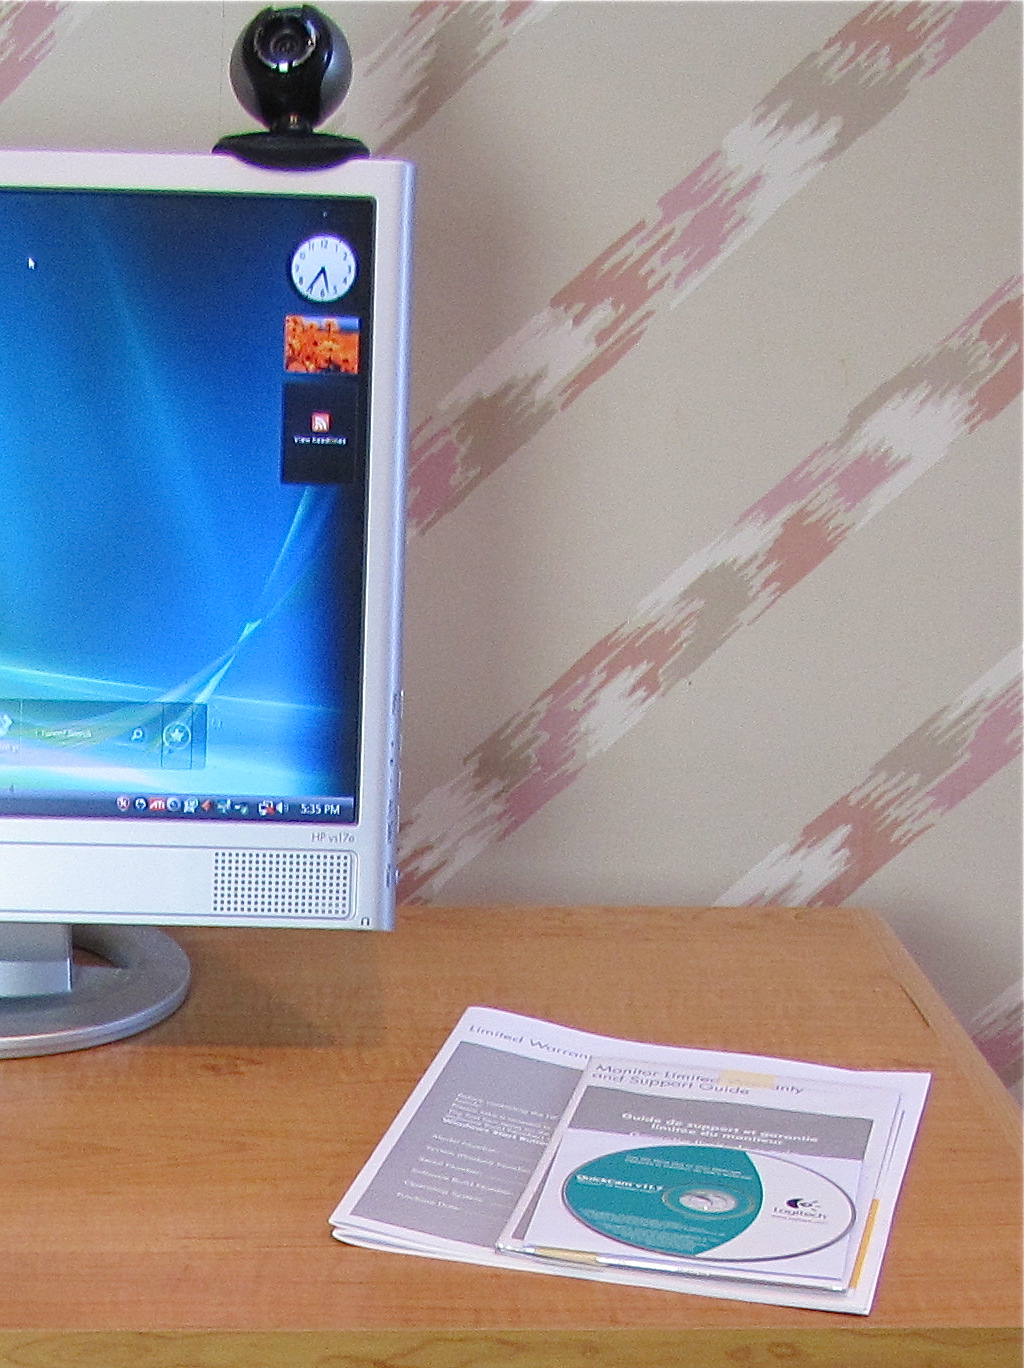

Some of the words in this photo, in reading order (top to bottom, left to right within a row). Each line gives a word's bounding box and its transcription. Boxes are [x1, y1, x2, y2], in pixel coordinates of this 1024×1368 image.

[300, 803, 322, 815] 5:35
[324, 804, 340, 815] PM
[312, 832, 326, 843] HP
[468, 1025, 524, 1045] Limited
[529, 1039, 588, 1060] Warran
[595, 1063, 659, 1078] Monitor
[591, 1072, 625, 1083] and
[629, 1076, 693, 1089] Support
[699, 1083, 750, 1095] Guide
[621, 1112, 661, 1126] Guide
[665, 1117, 683, 1127] de
[687, 1120, 739, 1134] support
[759, 1130, 819, 1143] garantie
[576, 1173, 634, 1187] QuickCam
[773, 1207, 827, 1220] Logitech
